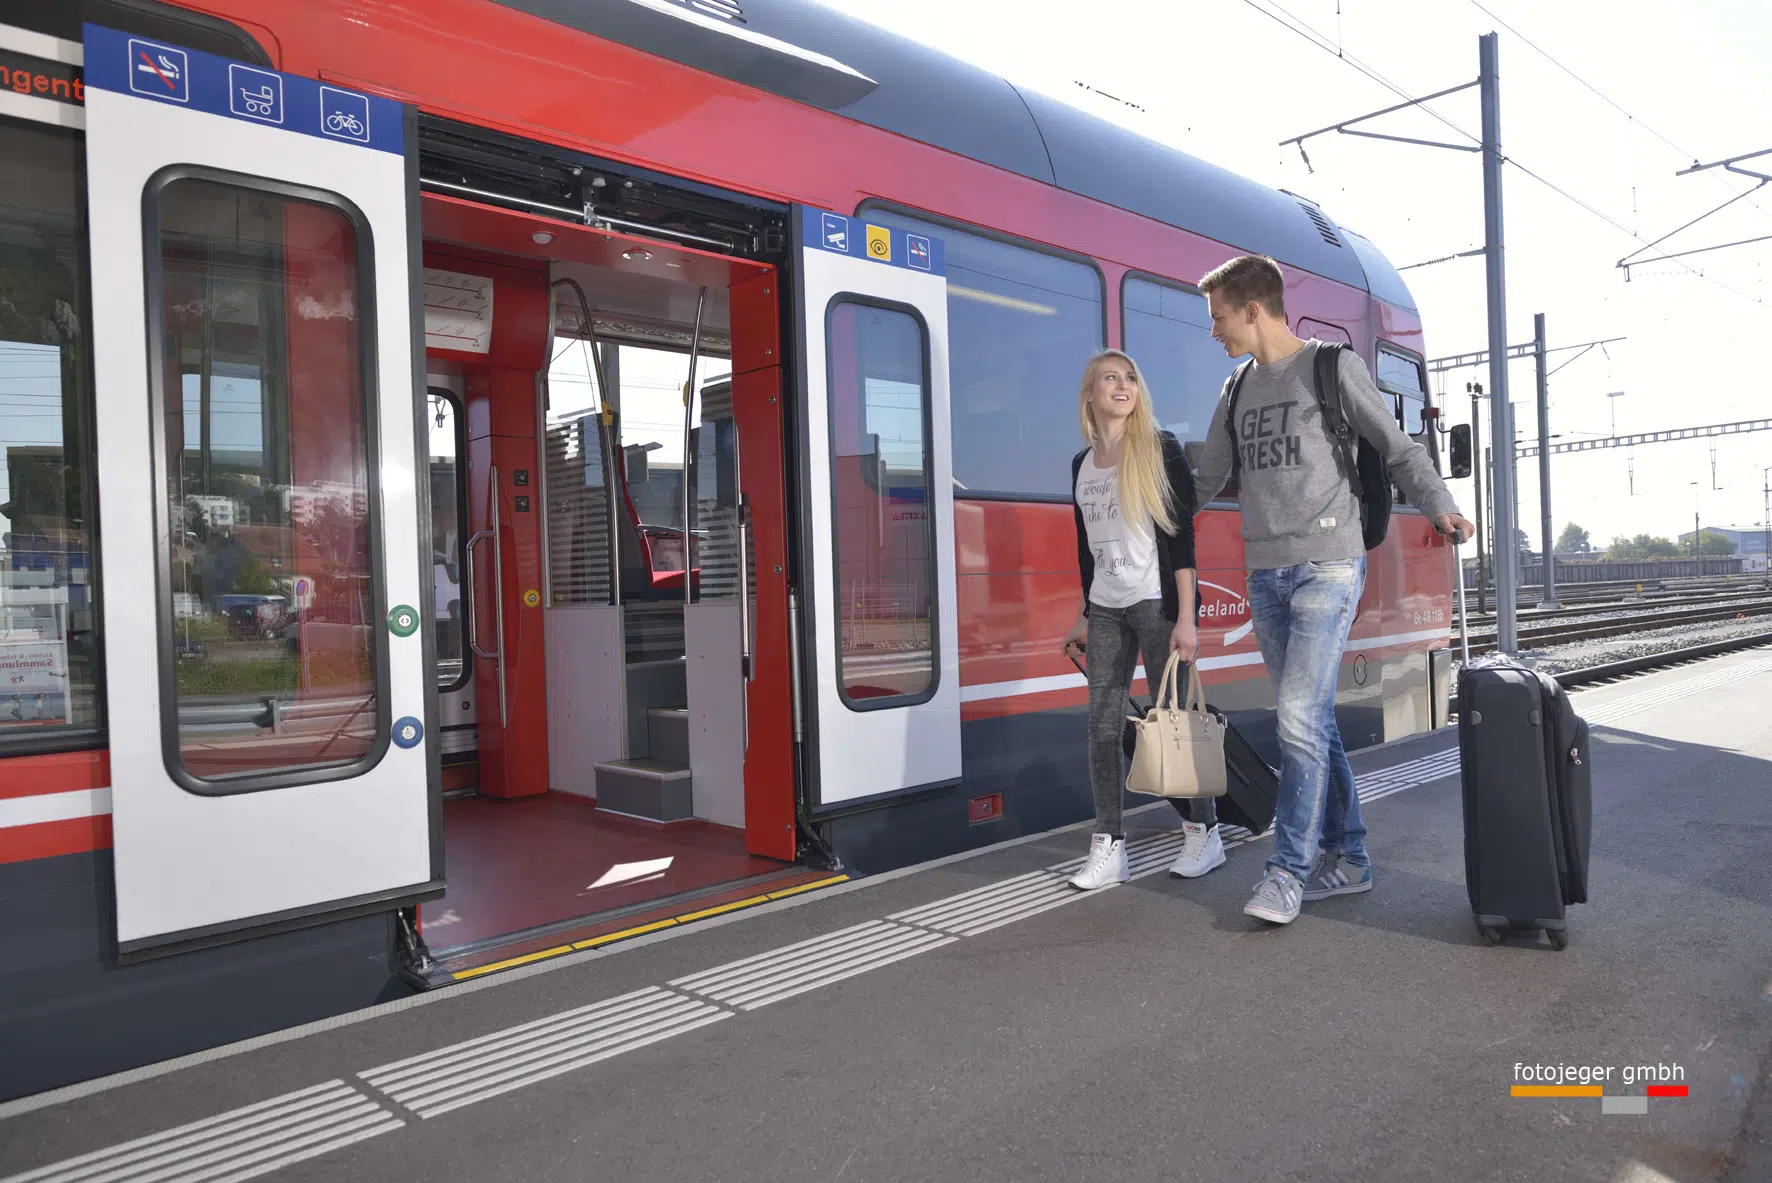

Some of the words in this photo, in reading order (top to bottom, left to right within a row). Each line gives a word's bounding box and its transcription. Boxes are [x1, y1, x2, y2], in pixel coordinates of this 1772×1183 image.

[1241, 400, 1299, 441] GET
[1240, 435, 1302, 473] FRESH
[1198, 598, 1246, 617] eeland
